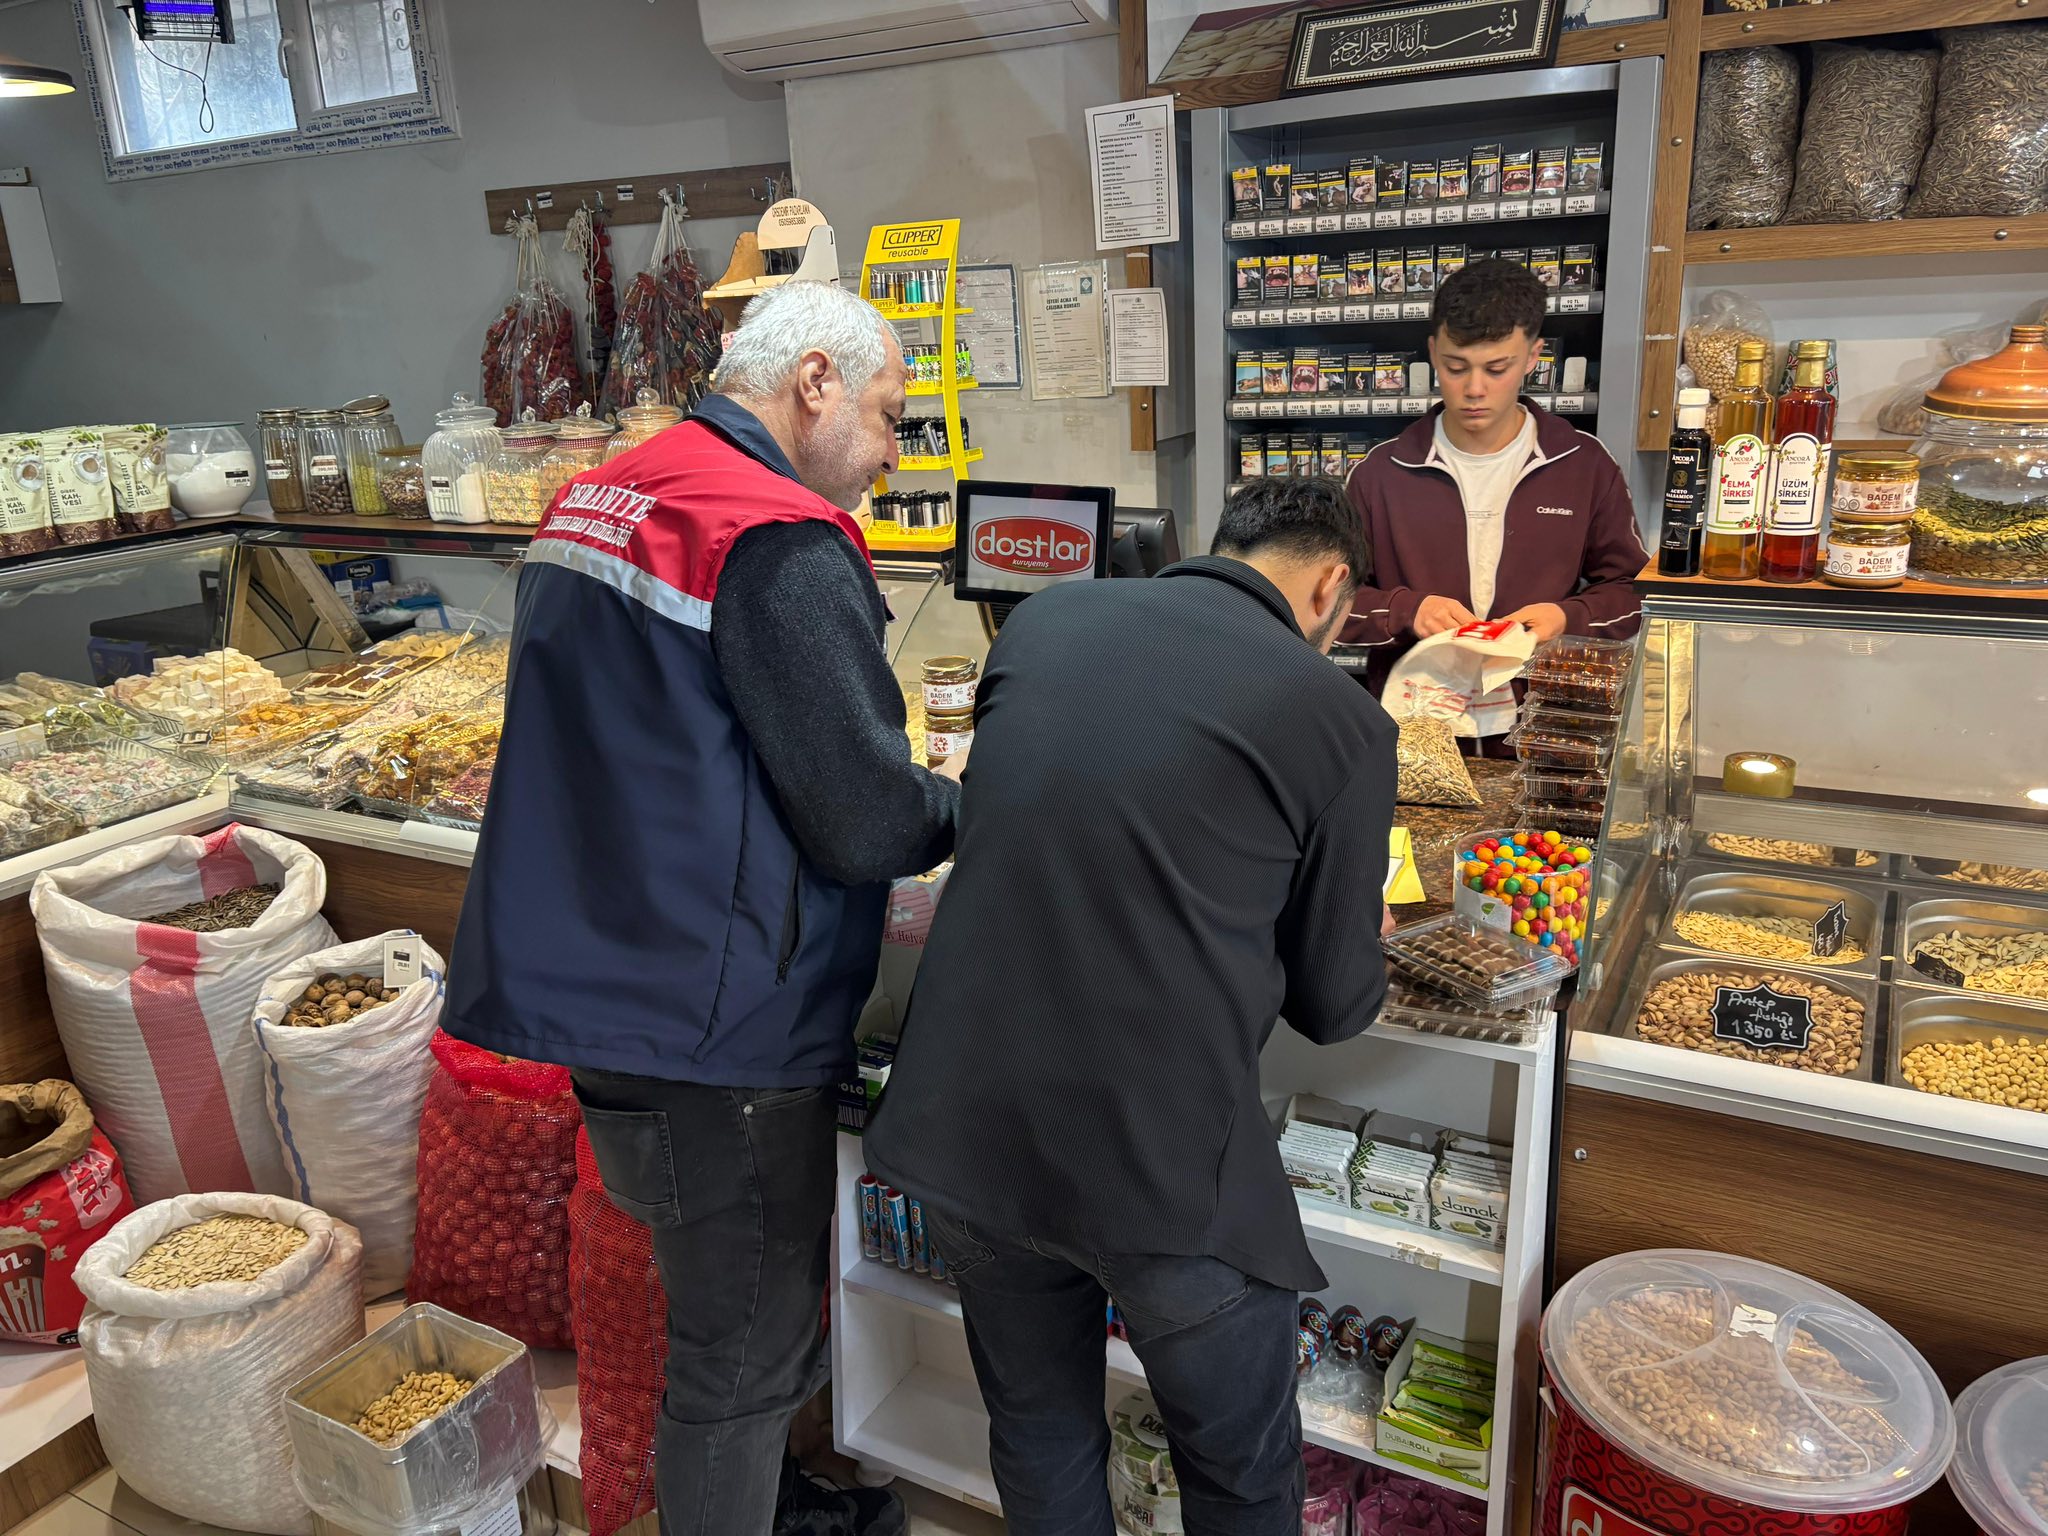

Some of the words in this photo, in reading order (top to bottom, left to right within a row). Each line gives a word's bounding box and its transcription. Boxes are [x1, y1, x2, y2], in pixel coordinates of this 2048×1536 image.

[337, 137, 360, 146] PenTech
[888, 229, 936, 245] CLIPPER
[888, 247, 929, 258] reusable
[1672, 454, 1694, 462] ANCORA
[1727, 480, 1751, 488] ELMA
[1782, 478, 1808, 488] ÜZÜM
[1722, 488, 1754, 497] SİRKESİ
[1778, 488, 1811, 498] SİRKESİ
[1867, 493, 1901, 501] BADEM
[559, 483, 658, 524] OSMANİYE
[1536, 506, 1558, 514] Calvin
[1557, 508, 1574, 516] Klein
[978, 525, 1089, 562] dostlar
[1012, 558, 1049, 569] kuruyemiş
[1859, 557, 1892, 565] BADEM
[898, 930, 928, 945] Helva
[1728, 992, 1776, 1011] Antep
[1731, 1019, 1774, 1039] 1350
[838, 1082, 864, 1096] OLO
[1285, 1162, 1336, 1183] damak
[1362, 1182, 1415, 1202] damak
[1441, 1196, 1498, 1220] damak
[1409, 1440, 1432, 1454] ROLL
